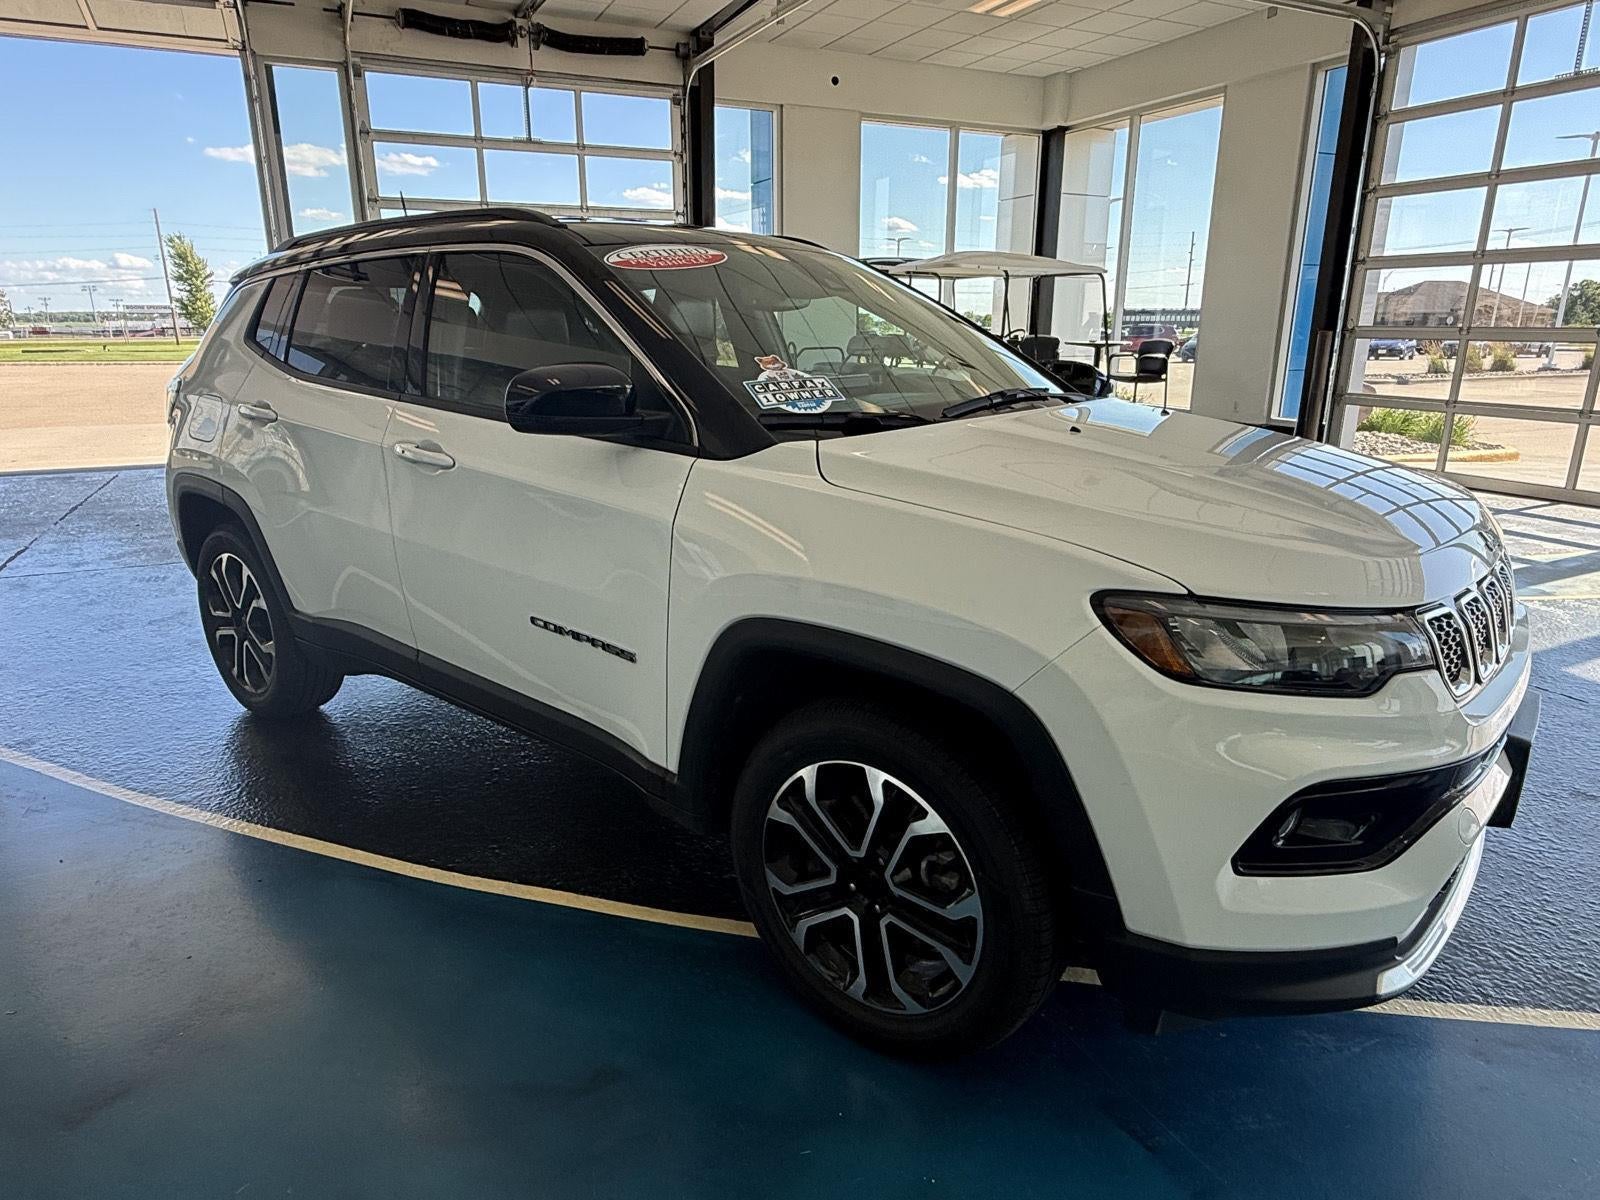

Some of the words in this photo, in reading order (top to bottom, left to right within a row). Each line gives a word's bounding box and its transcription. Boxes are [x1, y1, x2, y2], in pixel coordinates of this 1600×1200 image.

[616, 248, 709, 260] CERTIFIED
[754, 379, 829, 393] CARFAX
[774, 389, 836, 402] OWNER
[530, 616, 637, 664] COMPASS
